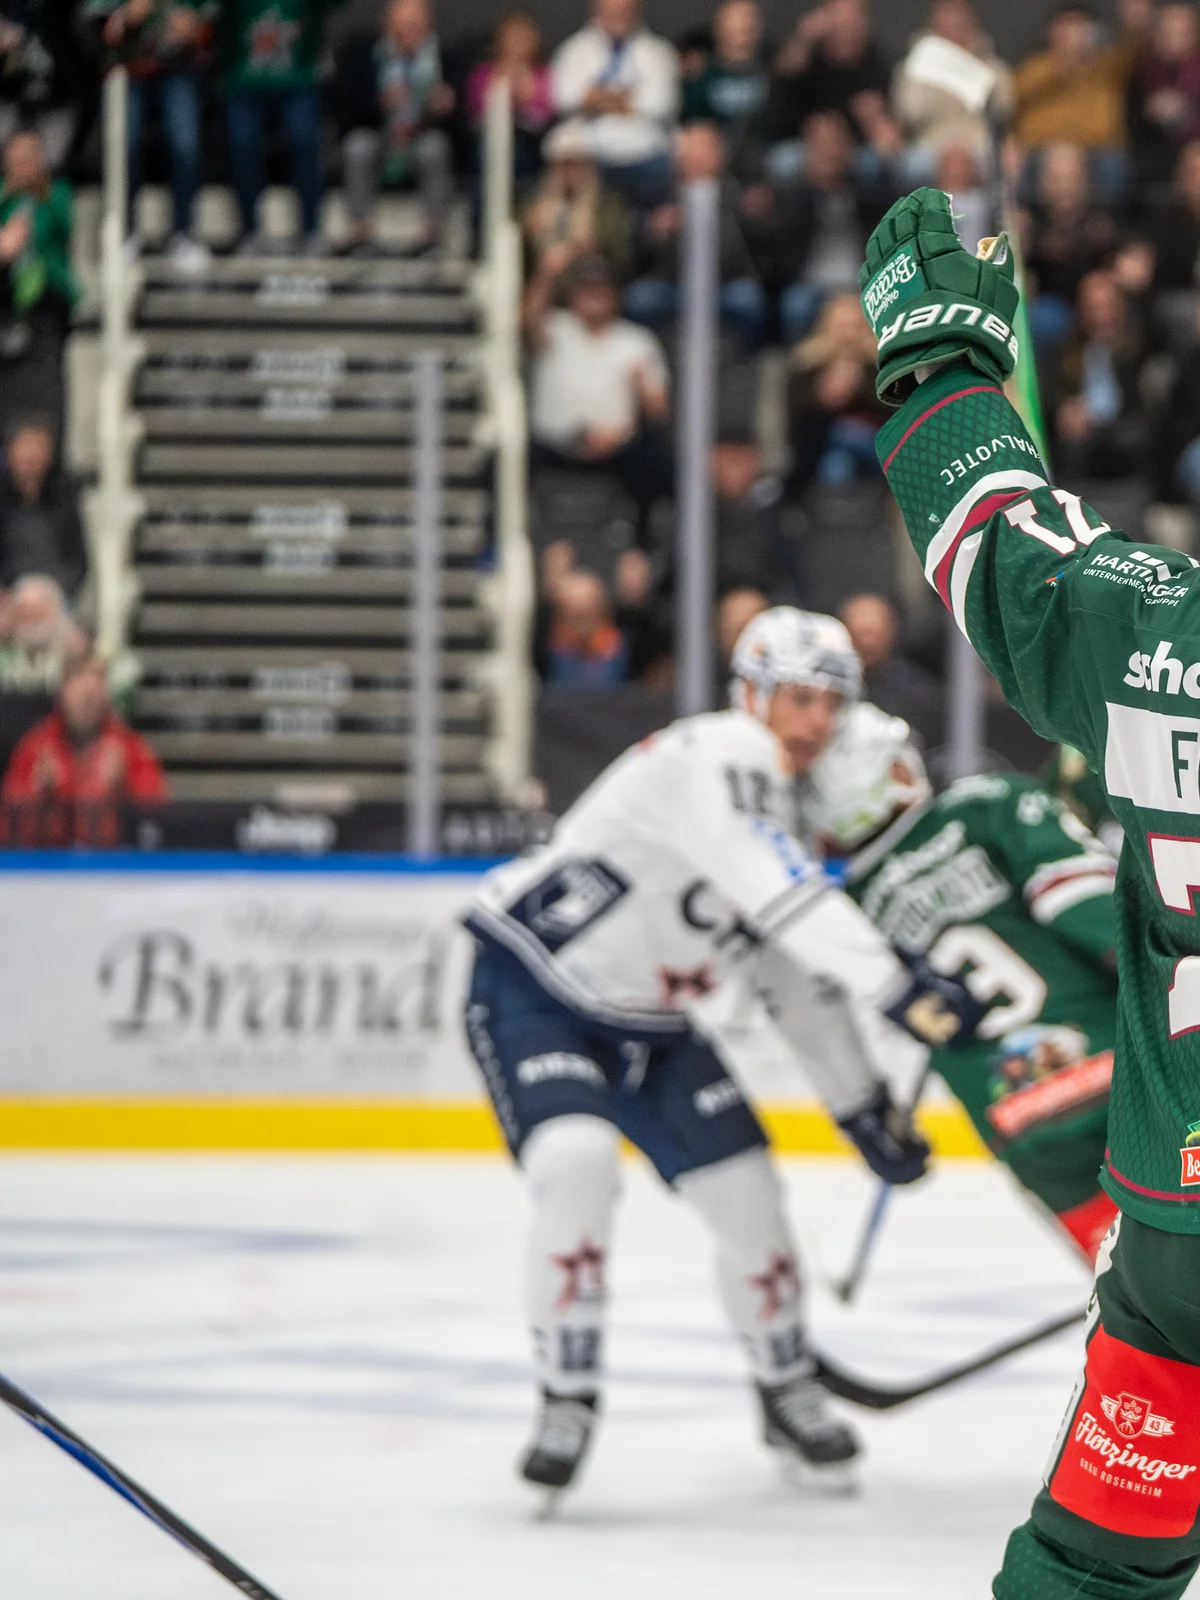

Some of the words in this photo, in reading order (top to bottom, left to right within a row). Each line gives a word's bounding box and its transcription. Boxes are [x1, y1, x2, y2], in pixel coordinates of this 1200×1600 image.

[866, 255, 917, 331] Brand
[940, 434, 1037, 486] HALVOTEC
[1083, 568, 1180, 607] UNTERNEHMENSGRUPPE
[1090, 553, 1190, 598] HARTINGER
[97, 927, 450, 1042] Brand
[1075, 1411, 1197, 1481] Flötzinger
[1149, 1419, 1160, 1431] 43
[1099, 1470, 1163, 1498] ROSENHEIM
